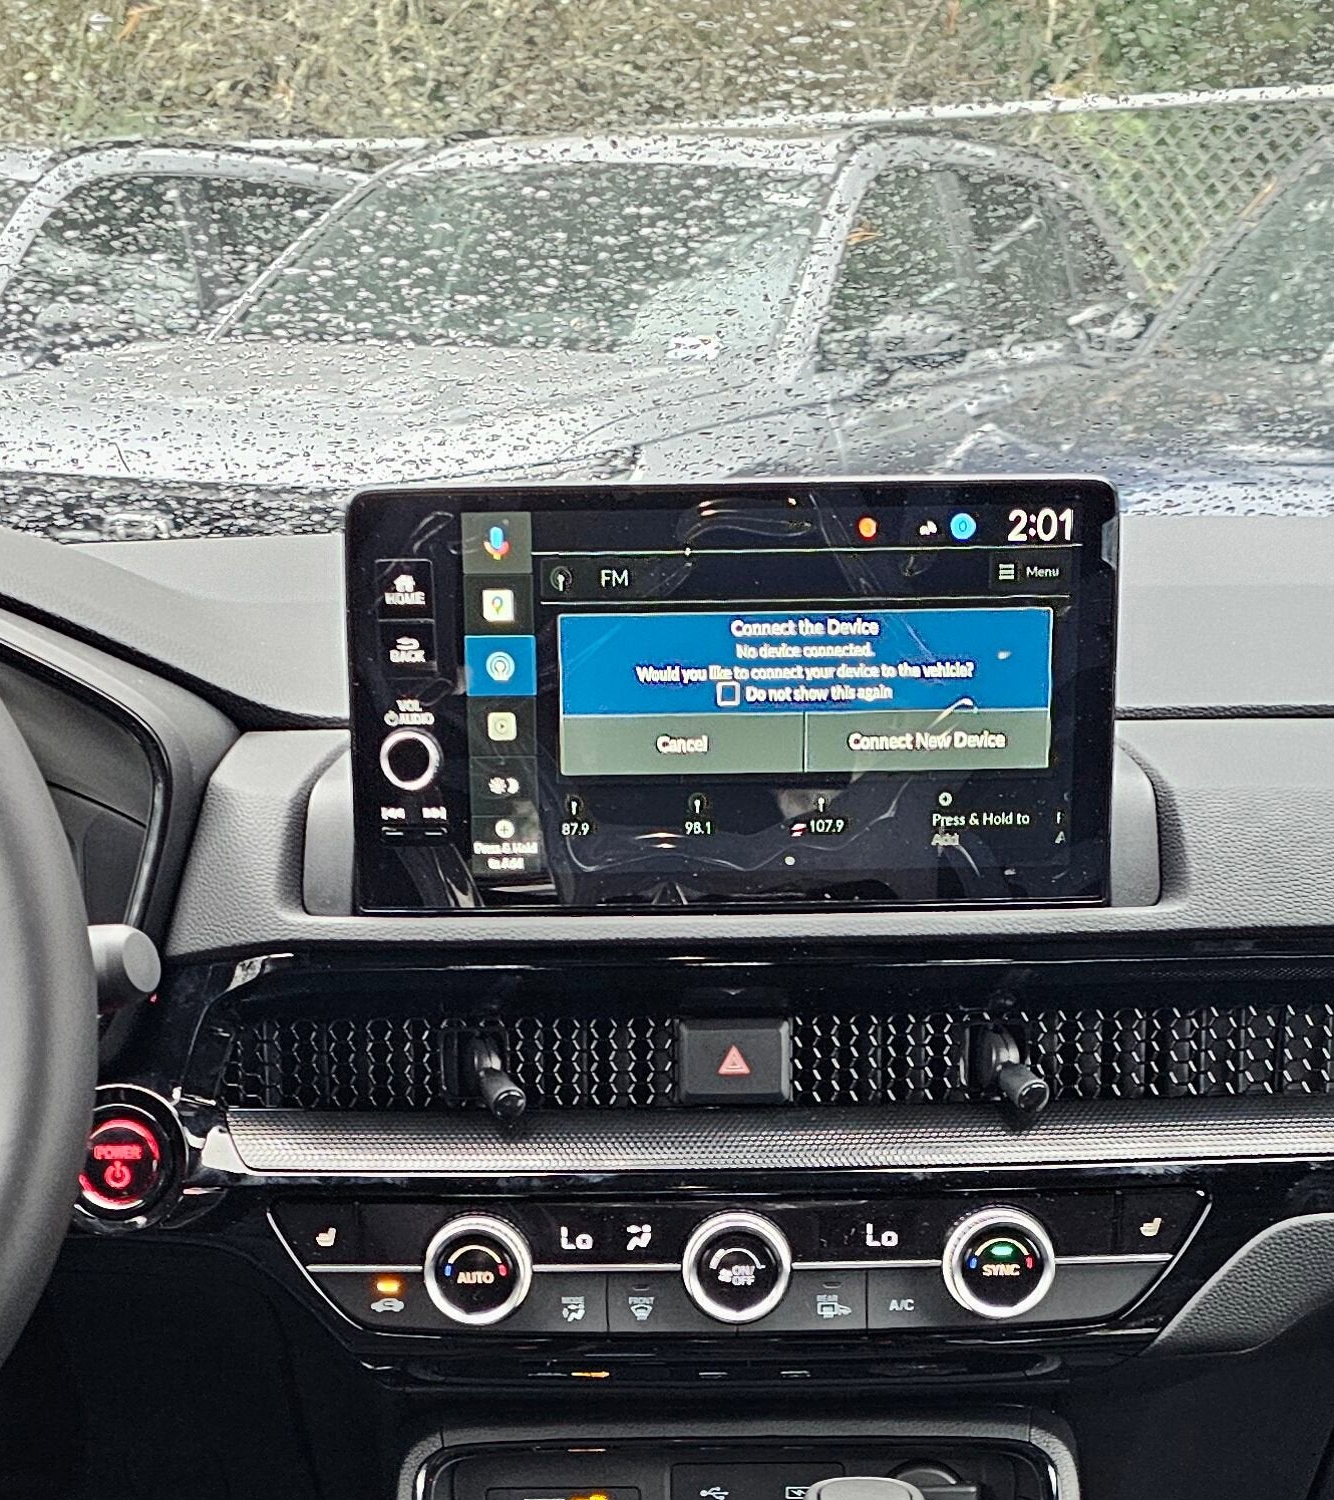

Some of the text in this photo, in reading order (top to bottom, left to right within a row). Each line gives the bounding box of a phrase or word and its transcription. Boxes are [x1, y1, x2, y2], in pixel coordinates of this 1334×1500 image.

[1007, 507, 1074, 542] 2:01
[600, 569, 629, 588] FM
[1026, 565, 1059, 578] Menu
[384, 591, 426, 606] HOME
[730, 618, 879, 637] Connect the Device
[389, 649, 426, 663] BACK
[736, 642, 875, 658] No device connected.
[636, 661, 974, 684] Would you like to connect your device to the vehicle?
[745, 684, 893, 702] Do not show this again
[656, 735, 708, 754] Cancel
[848, 730, 1006, 750] Connect New Device
[810, 818, 845, 834] 107.9
[932, 811, 1030, 827] Press & Hold to
[561, 822, 590, 836] 87.9
[684, 820, 712, 836] 98.1
[931, 832, 959, 847] Add
[93, 1144, 144, 1160] POWER
[560, 1226, 594, 1250] Lo
[865, 1223, 899, 1247] Lo
[456, 1271, 495, 1285] AUTO
[982, 1264, 1021, 1277] SYNC
[889, 1299, 915, 1312] A/C
